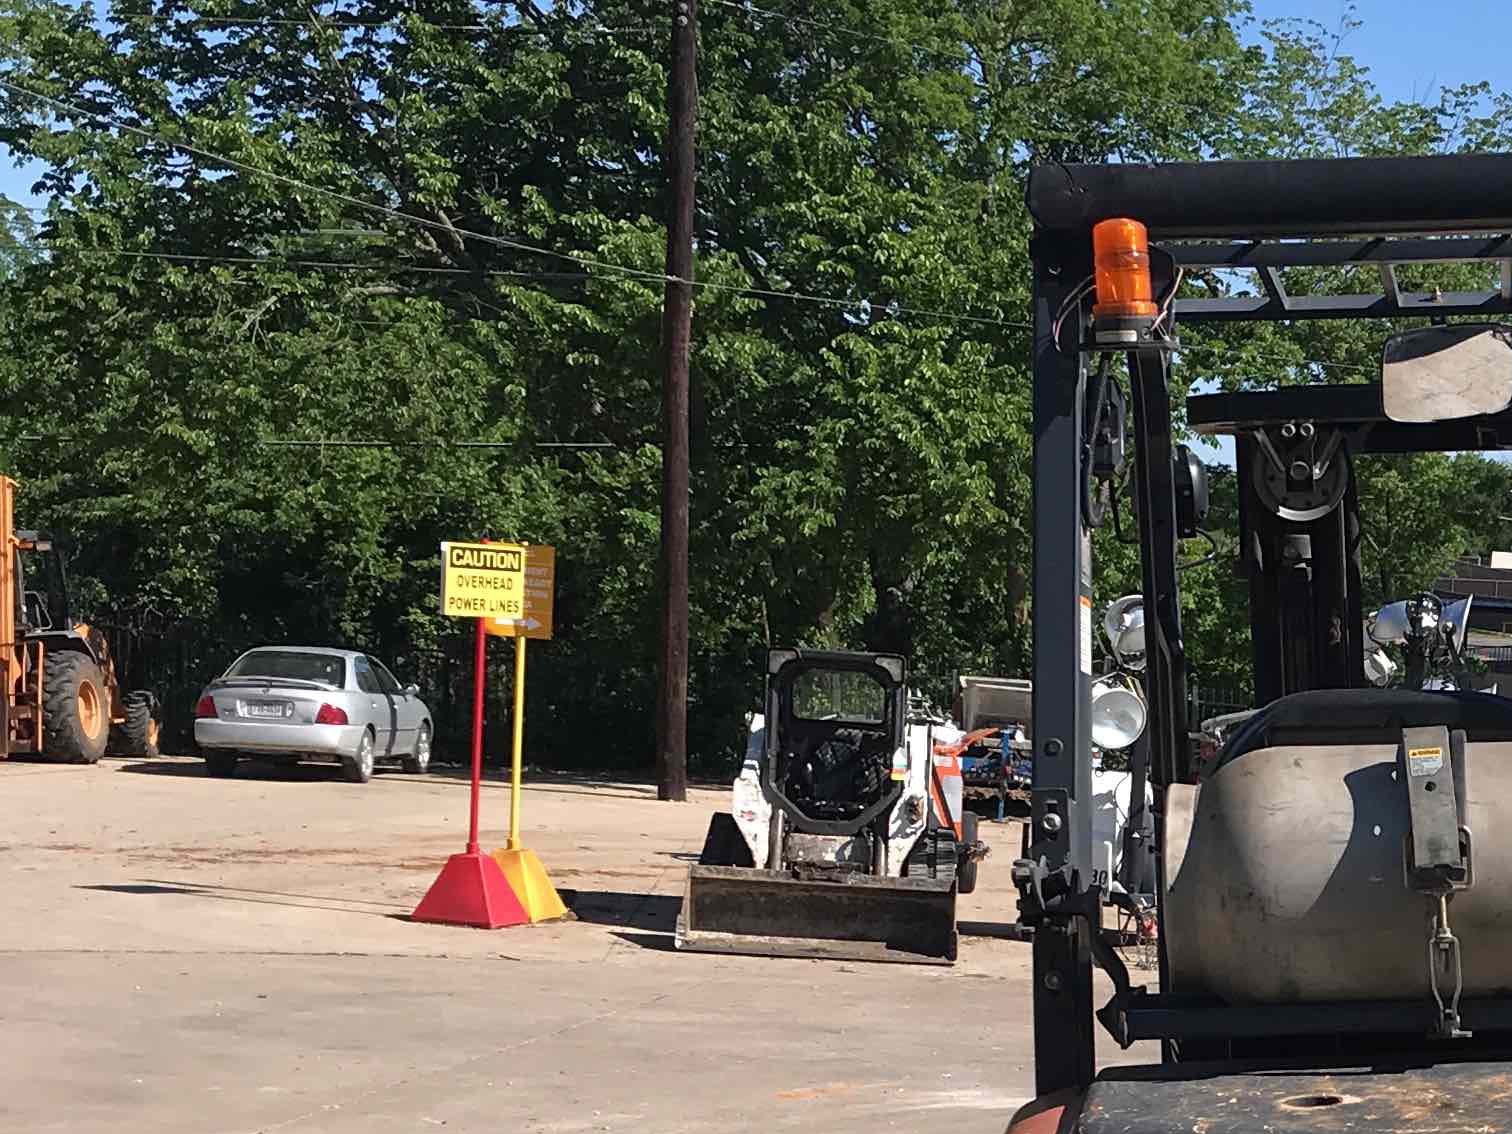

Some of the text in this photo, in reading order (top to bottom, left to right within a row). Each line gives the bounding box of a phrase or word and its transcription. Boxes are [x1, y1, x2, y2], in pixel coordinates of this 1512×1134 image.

[452, 549, 520, 570] CAUTION
[457, 574, 513, 590] OVERHEAD
[449, 596, 486, 611] POWER
[489, 599, 519, 613] LINES
